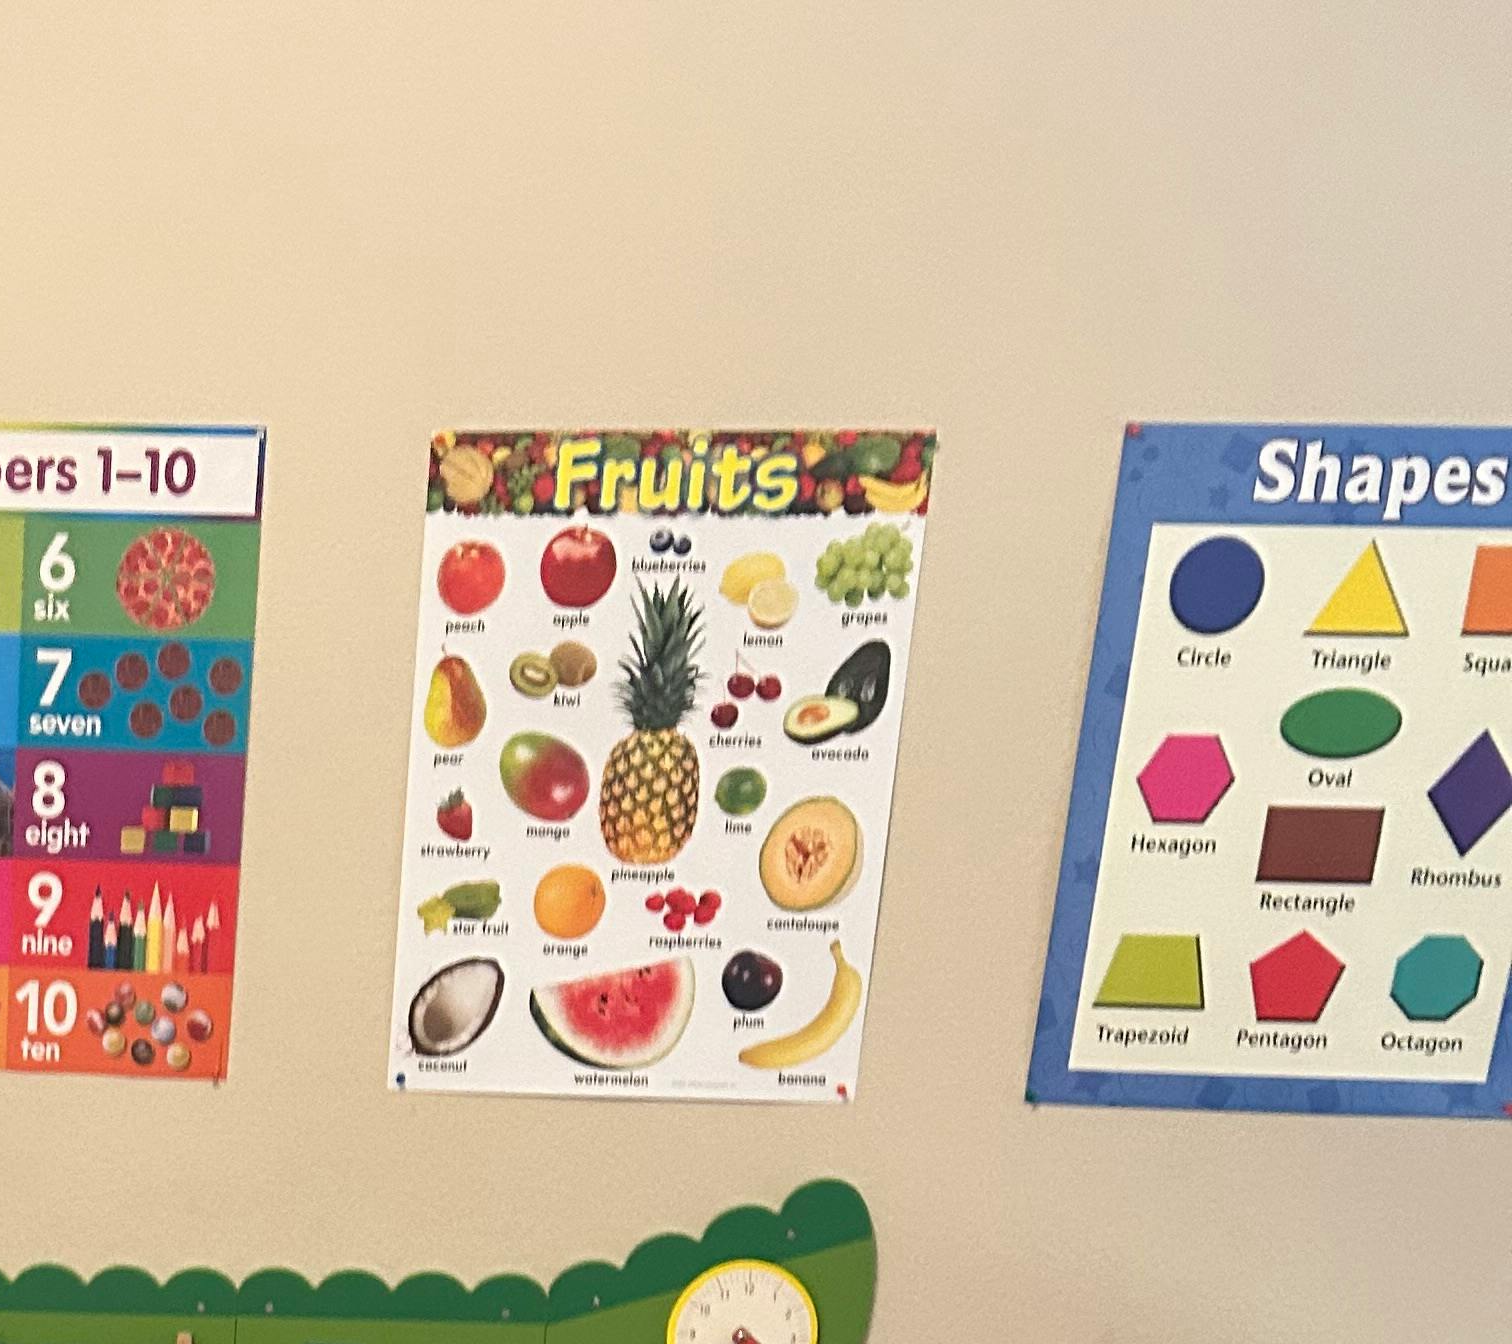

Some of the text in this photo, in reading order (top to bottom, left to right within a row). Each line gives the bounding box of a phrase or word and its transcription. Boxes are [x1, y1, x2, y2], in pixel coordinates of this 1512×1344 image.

[554, 436, 799, 511] Fruits
[1252, 437, 1509, 522] Shapes
[39, 532, 76, 591] 6
[631, 556, 707, 573] blueberries
[34, 594, 70, 621] six
[445, 618, 486, 637] peach
[553, 611, 590, 630] apple
[841, 611, 888, 629] grapes
[743, 632, 783, 647] lemon
[1177, 647, 1232, 668] Circle
[1312, 649, 1392, 675] Triangle
[36, 647, 73, 707] 7
[553, 692, 581, 707] kiwi
[29, 711, 101, 737] seven
[708, 733, 762, 748] cherries
[433, 752, 464, 768] pear
[811, 746, 869, 762] avocado
[1308, 768, 1353, 788] Oval
[32, 761, 66, 819] 8
[526, 825, 570, 842] mango
[725, 819, 752, 834] lime
[25, 819, 90, 854] eight
[1130, 833, 1217, 858] Hexagon
[420, 843, 491, 861] strawberry
[611, 867, 675, 884] pineapple
[1410, 867, 1502, 889] Rhombus
[27, 872, 63, 928] 9
[1259, 892, 1356, 916] Rectangle
[452, 920, 509, 935] star fruit
[766, 917, 840, 933] cantaloupe
[22, 931, 73, 956] nine
[542, 943, 588, 957] orange
[649, 934, 722, 950] raspberries
[15, 980, 78, 1036] 10
[733, 1012, 765, 1031] plum
[1096, 1025, 1189, 1048] Trapezoid
[1237, 1029, 1328, 1054] Pentagon
[1380, 1031, 1463, 1056] Octagon
[22, 1038, 61, 1062] ten
[418, 1060, 467, 1073] coconut
[573, 1072, 649, 1087] watermelon
[778, 1072, 826, 1087] banana
